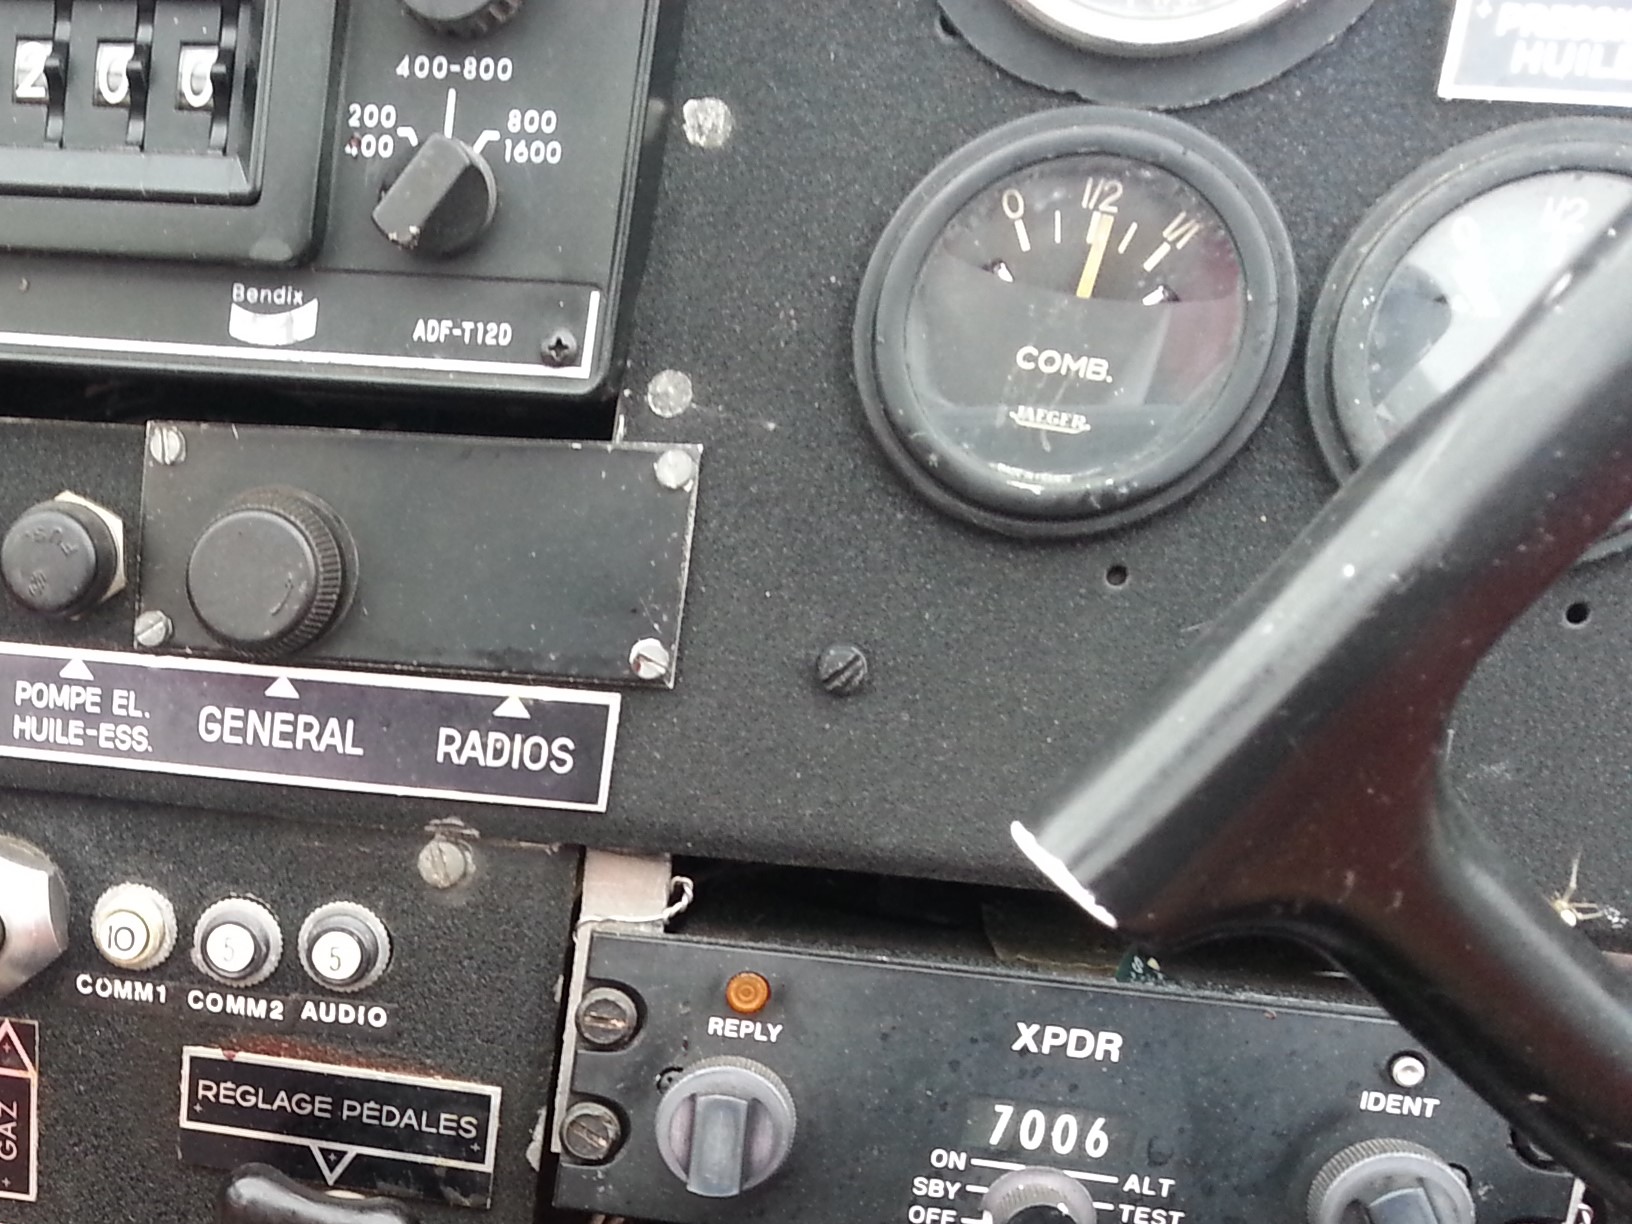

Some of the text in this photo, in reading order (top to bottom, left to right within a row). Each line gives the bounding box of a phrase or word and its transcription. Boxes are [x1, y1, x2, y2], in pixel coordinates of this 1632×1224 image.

[396, 56, 513, 82] 400-800
[347, 103, 397, 129] 200
[507, 110, 557, 134] 800
[504, 139, 562, 164] 1600
[1002, 188, 1025, 220] 0
[1082, 176, 1124, 213] 1/2
[232, 284, 304, 306] Bendix
[1016, 345, 1113, 383] COMB.
[1017, 405, 1089, 430] JAEGER
[15, 681, 151, 719] POMPE EL.
[12, 715, 153, 753] HUILE-ESS.
[198, 705, 364, 757] GENERAL
[436, 727, 576, 775] RADIOS
[106, 924, 135, 951] 10
[223, 936, 236, 962] 5
[329, 946, 342, 972] 5
[75, 973, 167, 1003] COMM1
[187, 989, 284, 1020] COMM2
[301, 1001, 388, 1028] AUDIO
[707, 1016, 783, 1043] REPLY
[1012, 1022, 1123, 1063] XPDR
[196, 1079, 479, 1140] RÉGLAGE PÉDALES
[1359, 1090, 1441, 1118] IDENT
[989, 1104, 1109, 1158] 7006
[930, 1149, 967, 1171] ON
[912, 1177, 961, 1200] SBY
[1123, 1174, 1175, 1198] ALT
